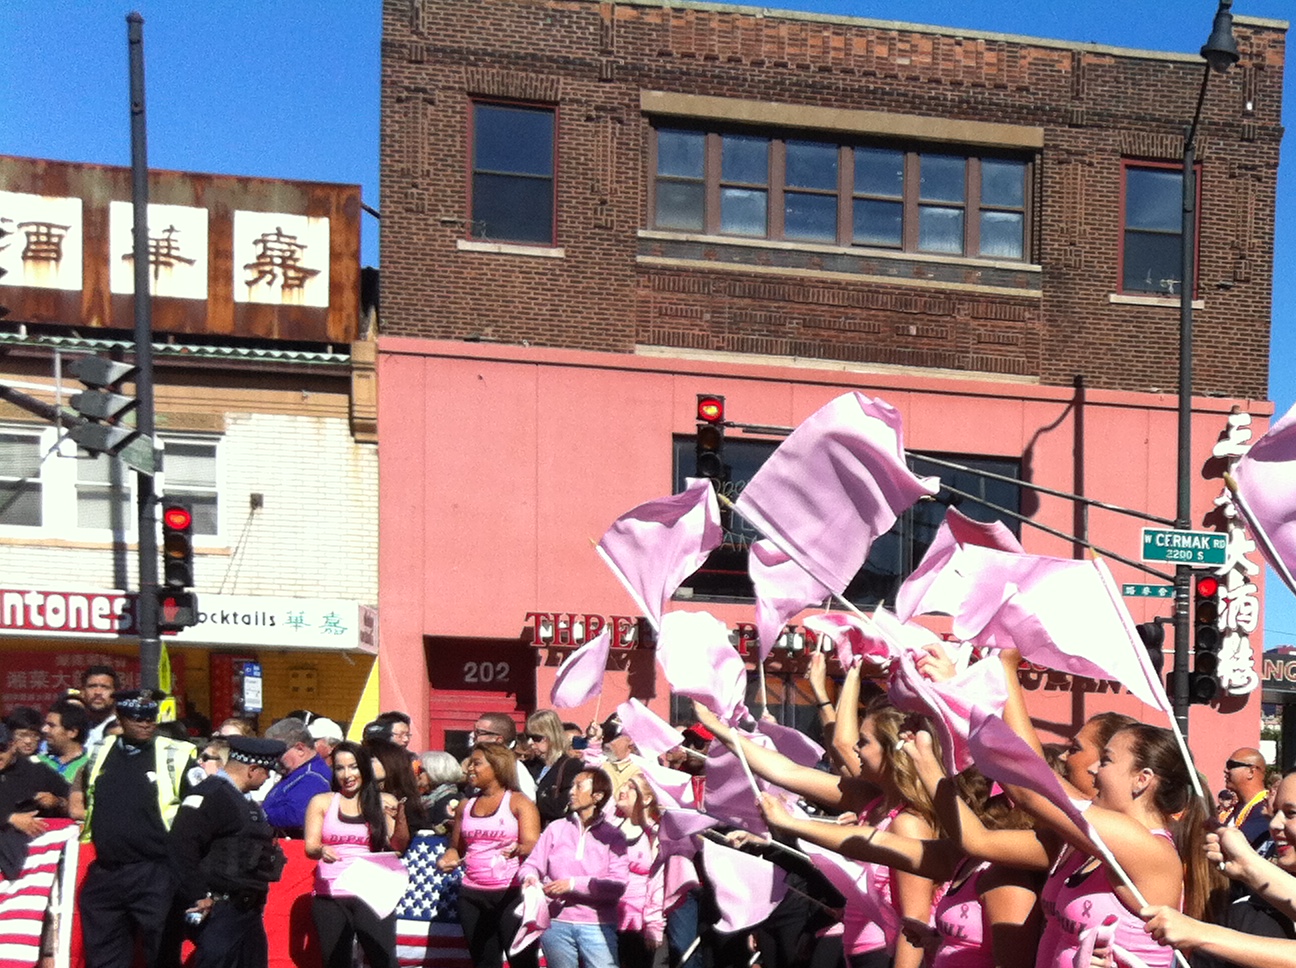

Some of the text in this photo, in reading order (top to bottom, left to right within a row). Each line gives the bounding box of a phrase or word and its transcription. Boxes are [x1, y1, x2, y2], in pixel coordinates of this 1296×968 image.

[1144, 533, 1226, 549] W CERMAK RD
[1166, 549, 1204, 560] 2200 S
[198, 609, 276, 627] ocktails
[464, 661, 510, 682] 202
